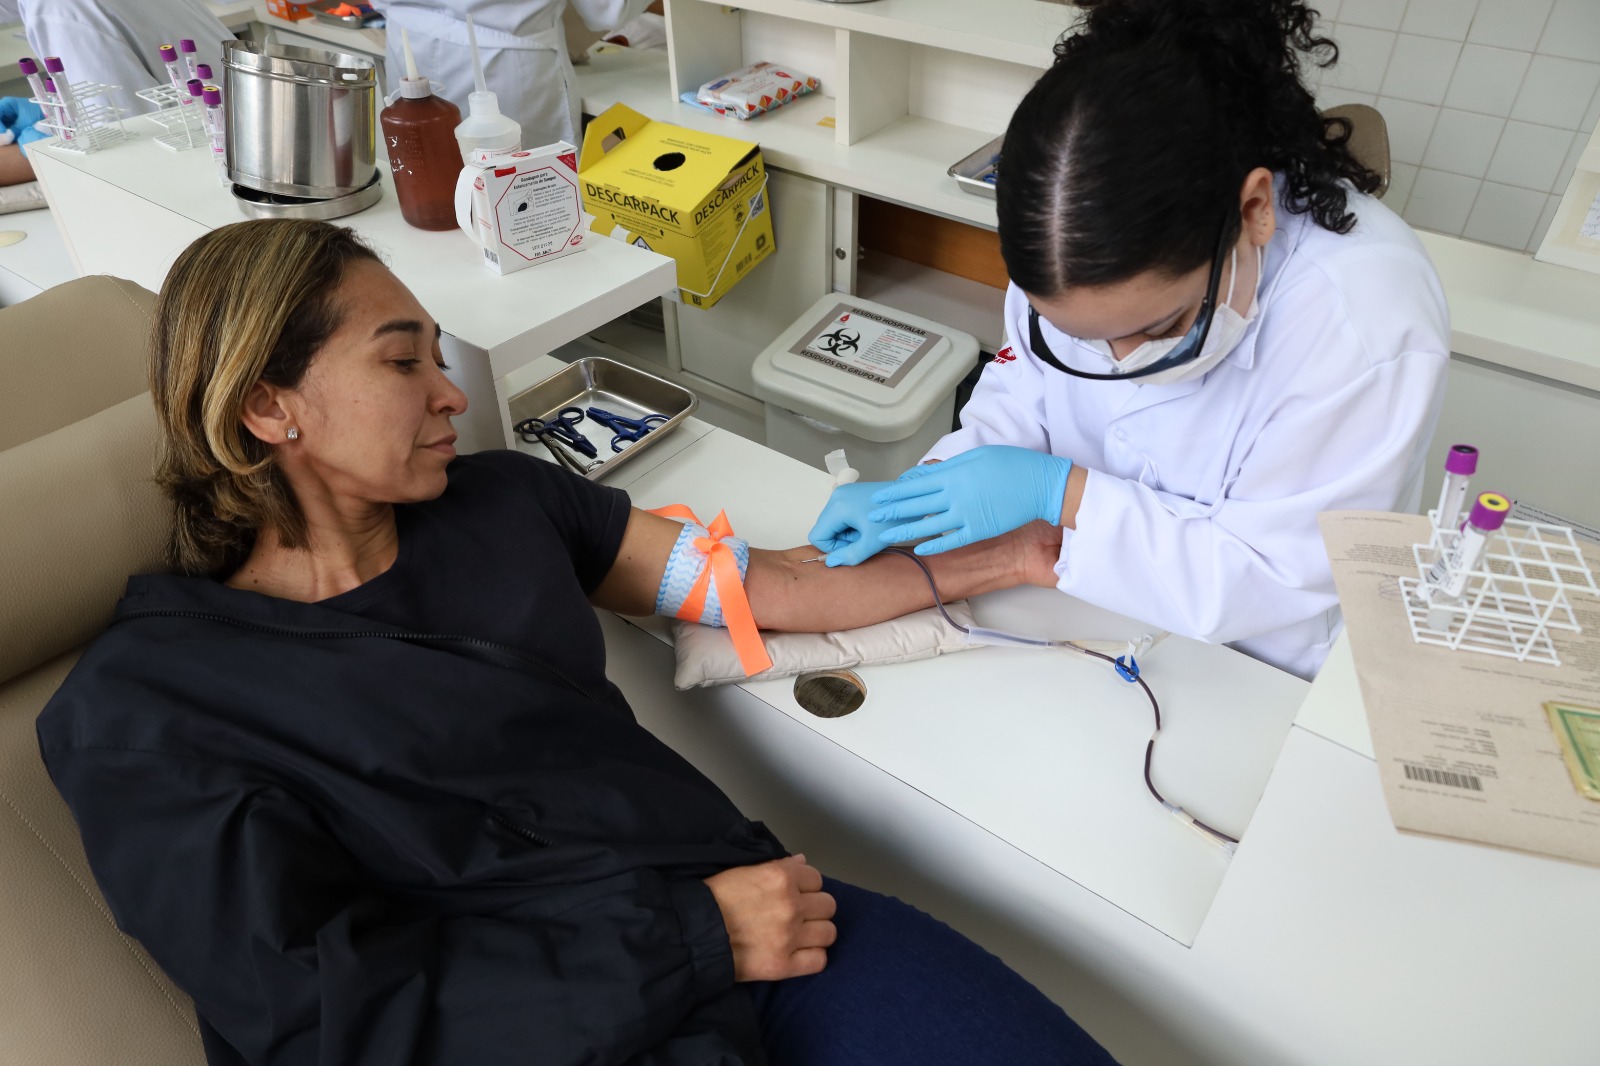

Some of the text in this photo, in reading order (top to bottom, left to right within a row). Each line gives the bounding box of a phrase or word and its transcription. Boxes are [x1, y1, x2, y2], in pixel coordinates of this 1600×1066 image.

[586, 182, 680, 225] DESCARPACK
[695, 162, 760, 226] DESCARPACK
[851, 307, 926, 336] RESÍDUO HOSPITALAR
[800, 349, 836, 366] RESÍDUOS
[835, 362, 847, 370] DO
[847, 366, 875, 380] GRUPO
